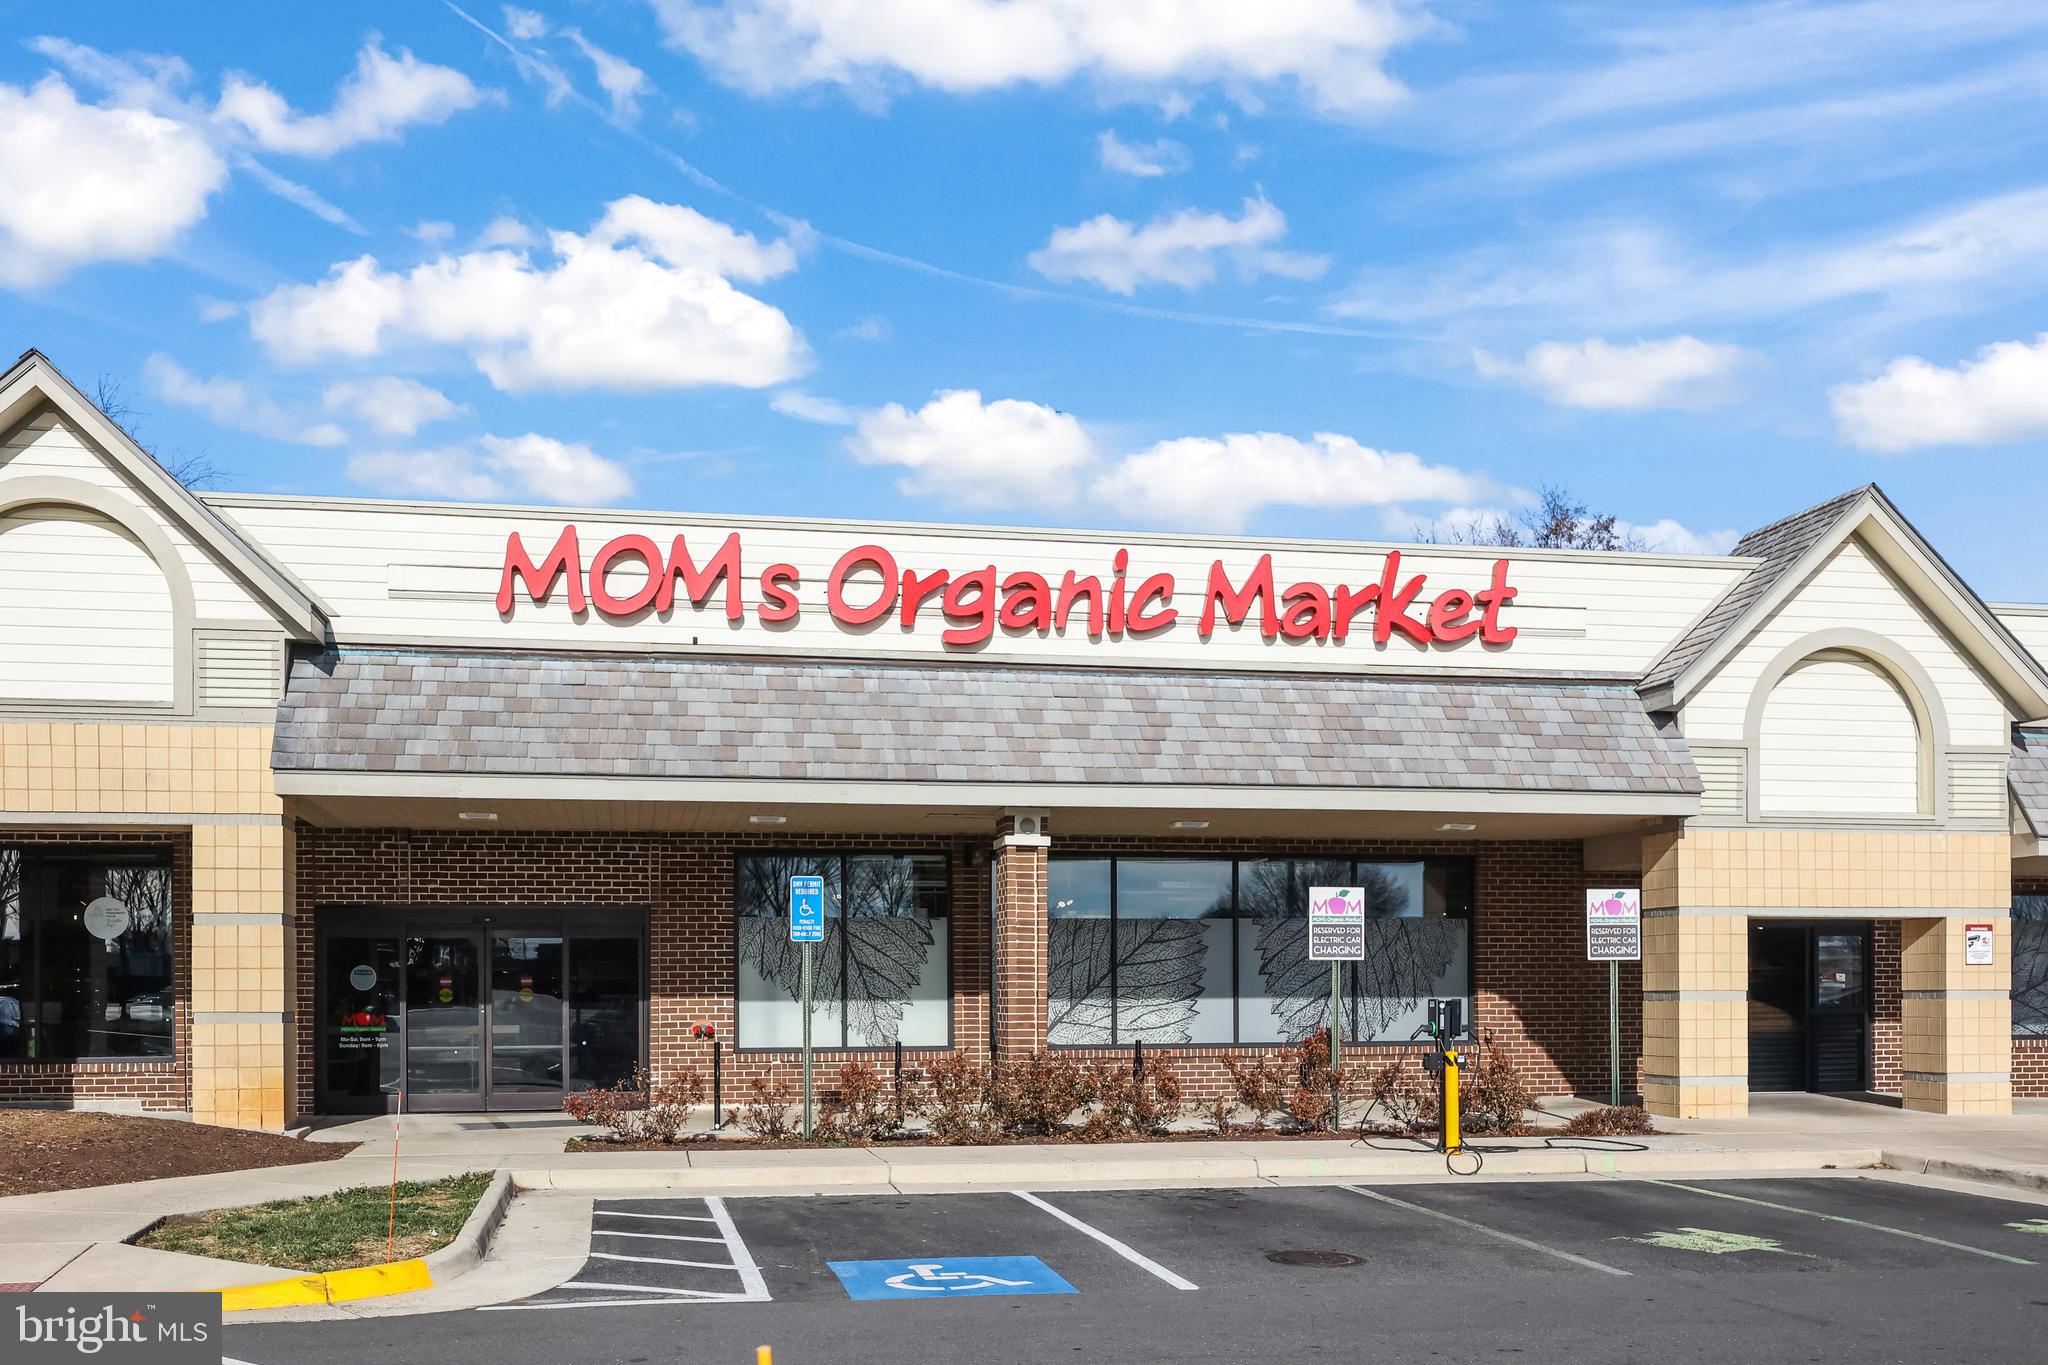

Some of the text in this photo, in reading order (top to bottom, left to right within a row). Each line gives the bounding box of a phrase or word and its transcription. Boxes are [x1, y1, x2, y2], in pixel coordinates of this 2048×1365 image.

[828, 546, 1178, 645] Organic
[1199, 551, 1517, 644] Market
[1591, 927, 1637, 935] RESERVED FOR
[1313, 936, 1361, 944] ELECTRIC CAR
[1591, 936, 1637, 944] ELECTRIC CAR
[1313, 946, 1361, 954] CHARGING
[1591, 946, 1637, 955] CHARGING
